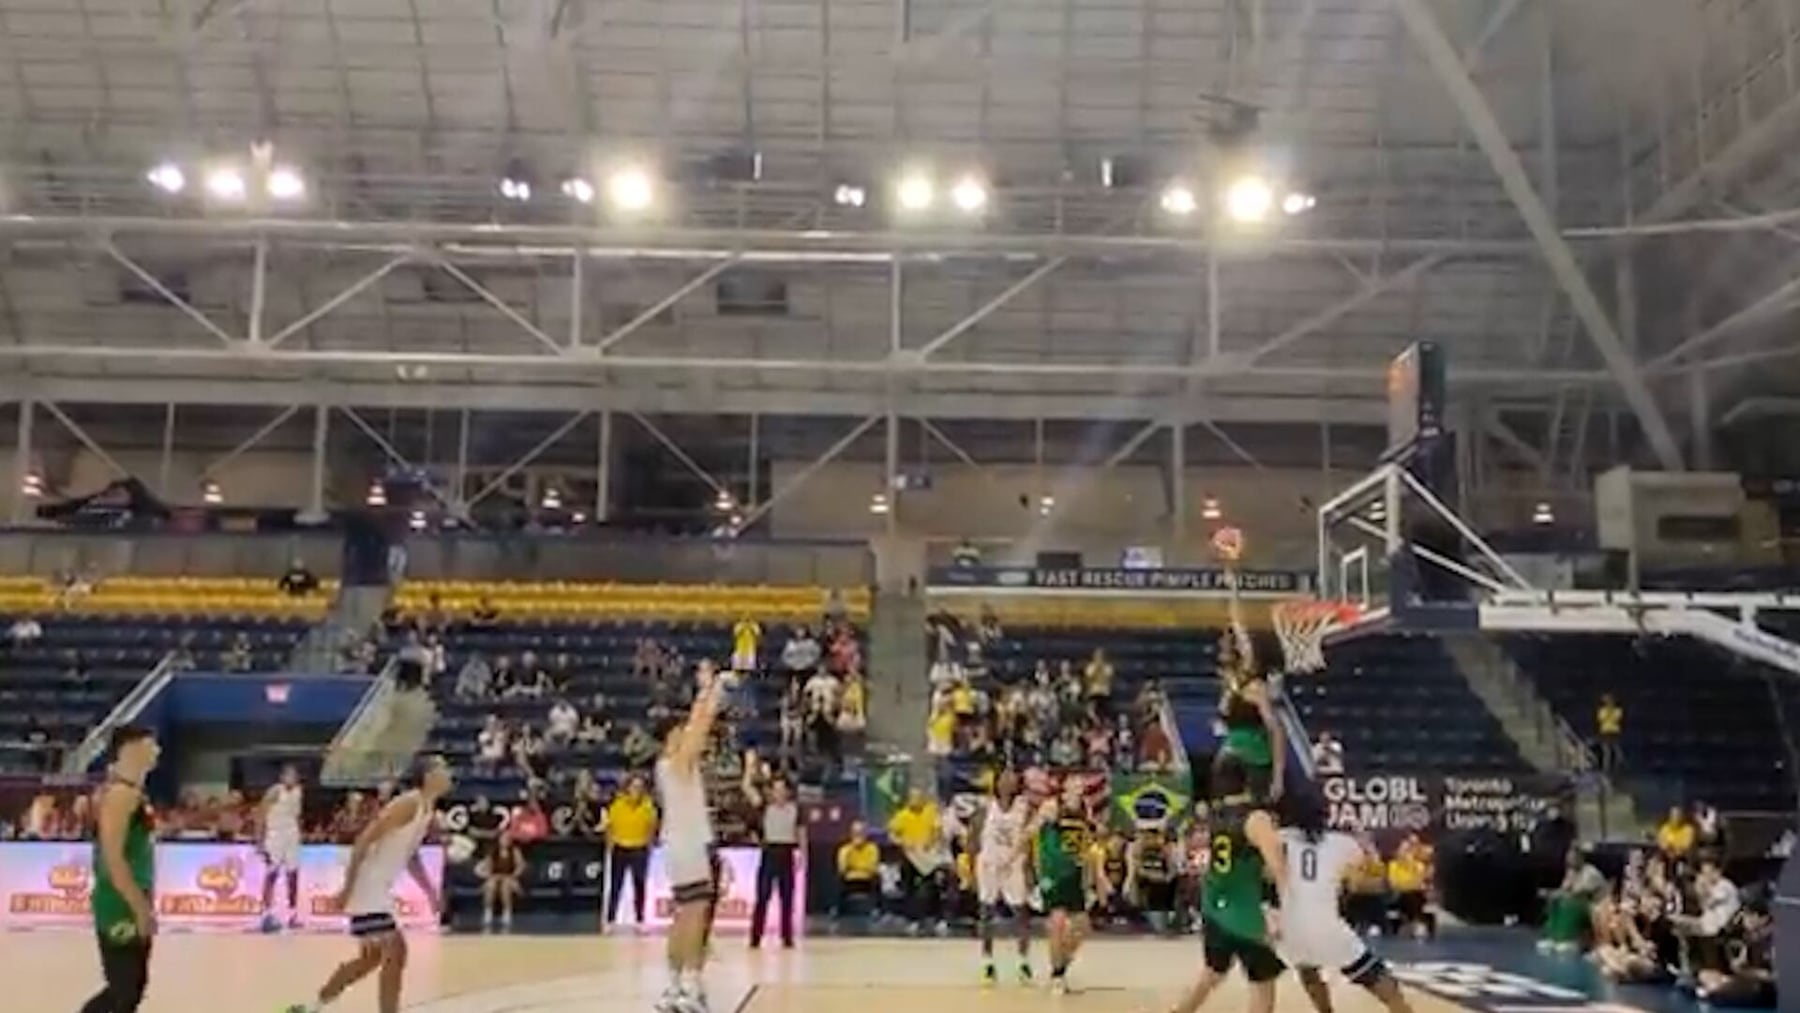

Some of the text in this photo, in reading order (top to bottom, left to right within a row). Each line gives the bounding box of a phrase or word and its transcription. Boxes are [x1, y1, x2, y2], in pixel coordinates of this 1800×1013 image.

[1036, 569, 1078, 587] FAST
[1082, 570, 1145, 588] RESCUE
[1150, 571, 1212, 588] PIMPLE
[1324, 777, 1428, 801] GLOBL
[1327, 802, 1388, 829] JAM
[1212, 834, 1232, 874] 3
